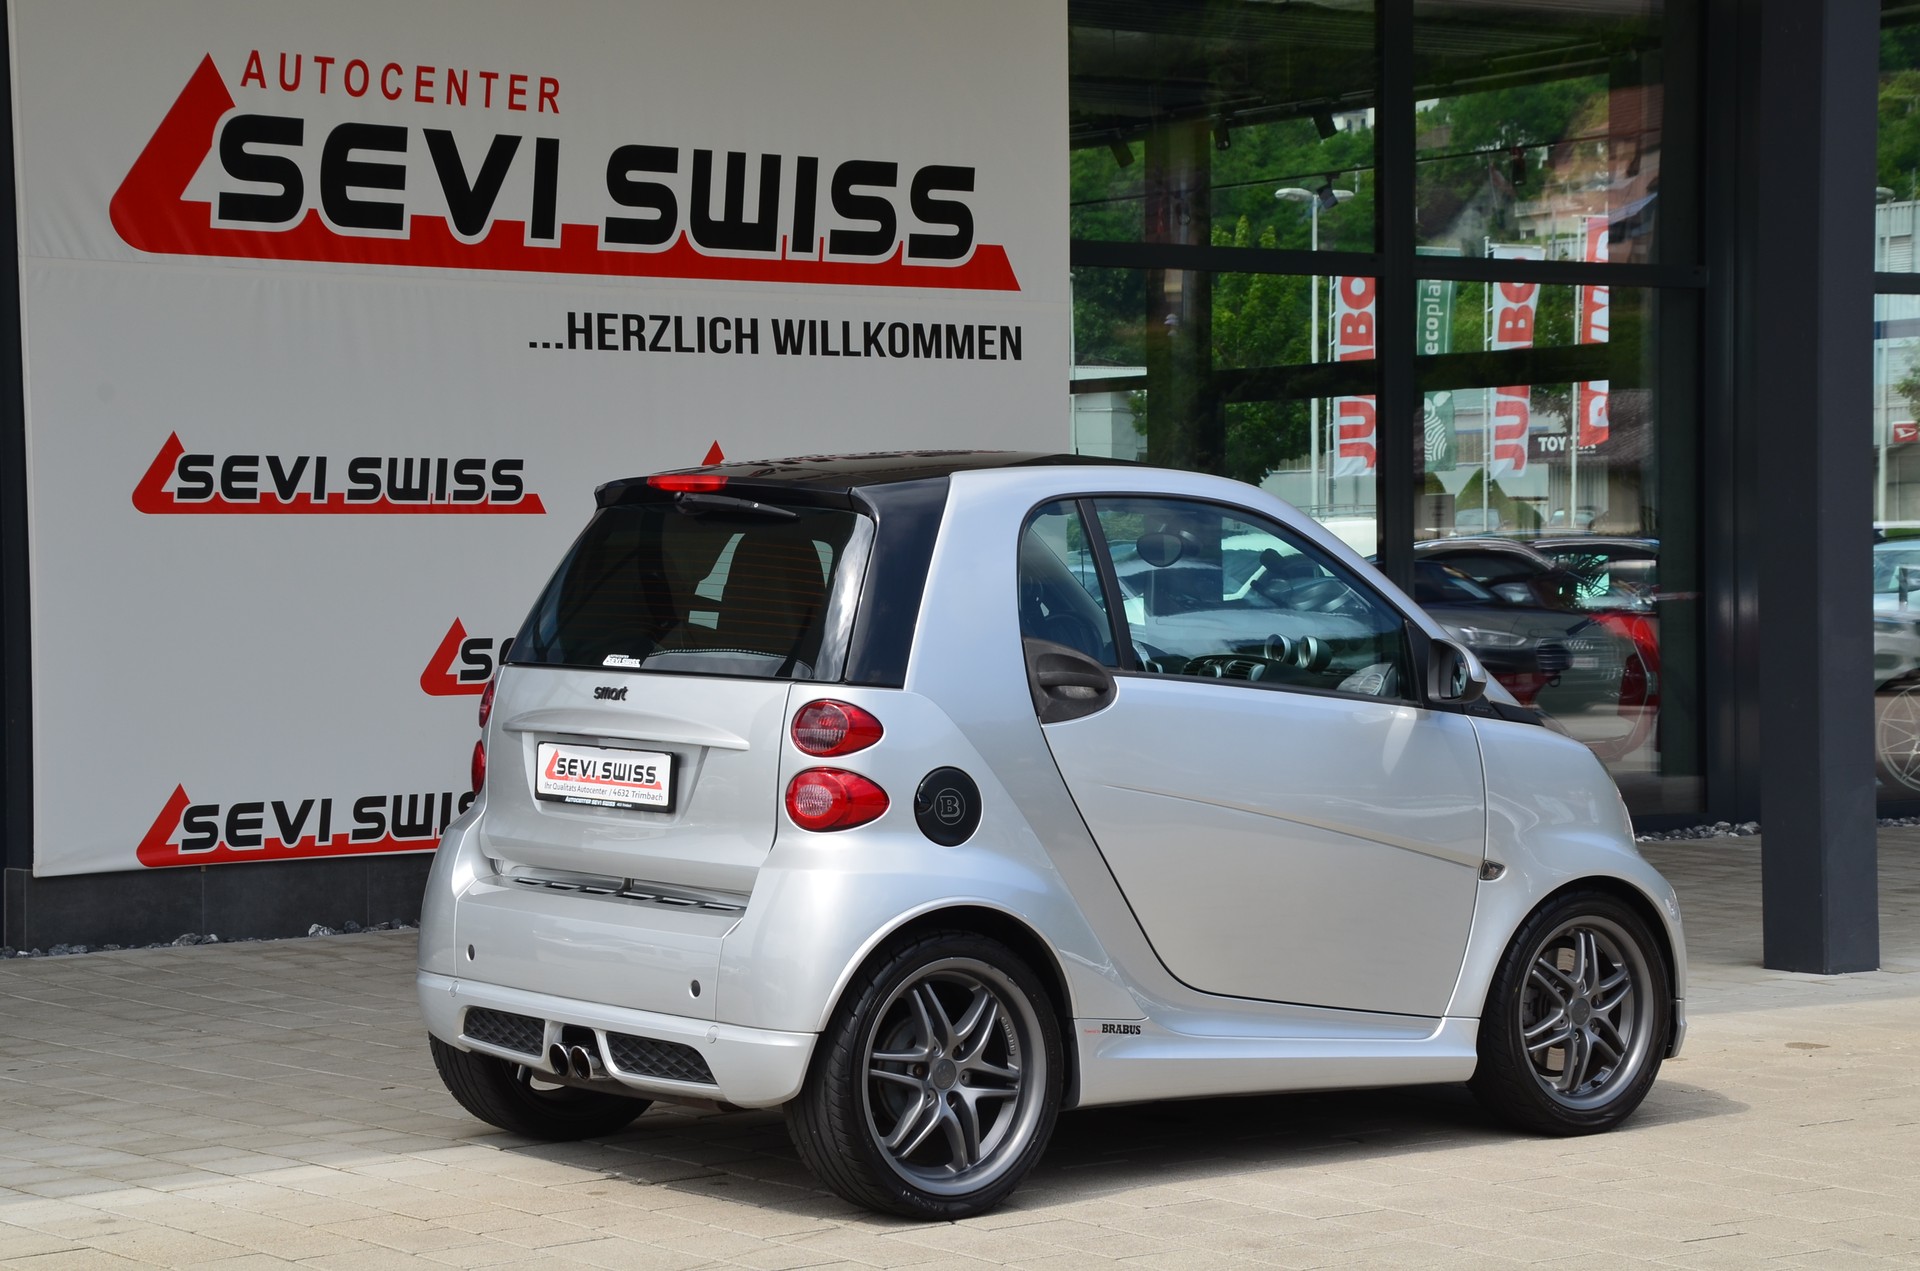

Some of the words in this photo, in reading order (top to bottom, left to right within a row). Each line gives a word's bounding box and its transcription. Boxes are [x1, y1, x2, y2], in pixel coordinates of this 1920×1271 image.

[241, 50, 560, 114] AUTOCENTER
[218, 113, 560, 241] SEVI
[603, 144, 976, 261] SWISS
[529, 311, 759, 355] ...HERZLICH
[772, 319, 1022, 361] WILLKOMMEN
[1425, 280, 1443, 355] ecopla
[176, 454, 328, 502] SEVI
[346, 457, 524, 502] SWISS
[594, 686, 628, 701] smart
[556, 757, 597, 778] SEVI
[601, 762, 657, 784] SWISS
[577, 785, 607, 795] Autocenter
[632, 790, 663, 801] Trimbach
[181, 797, 333, 851] SEVI
[350, 791, 477, 842] SWI
[940, 795, 960, 818] B
[1102, 1023, 1141, 1035] BRABUS
